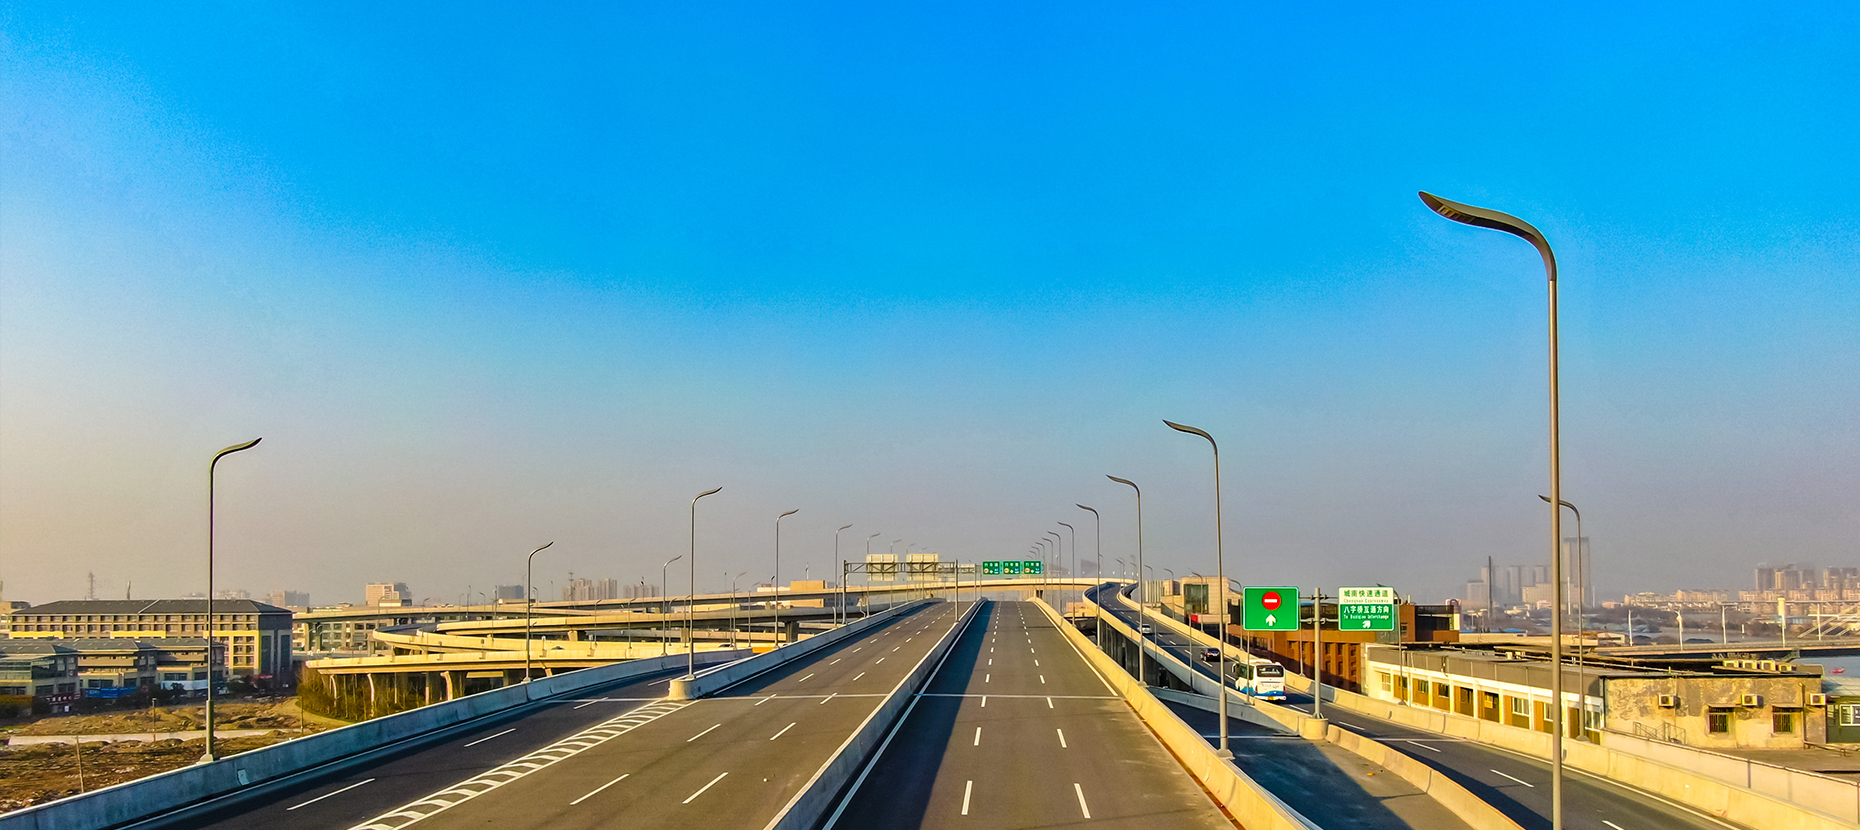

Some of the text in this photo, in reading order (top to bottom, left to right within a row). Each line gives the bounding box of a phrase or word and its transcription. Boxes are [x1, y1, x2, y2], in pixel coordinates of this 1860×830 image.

[1344, 605, 1389, 613] 八字桥互通方向
